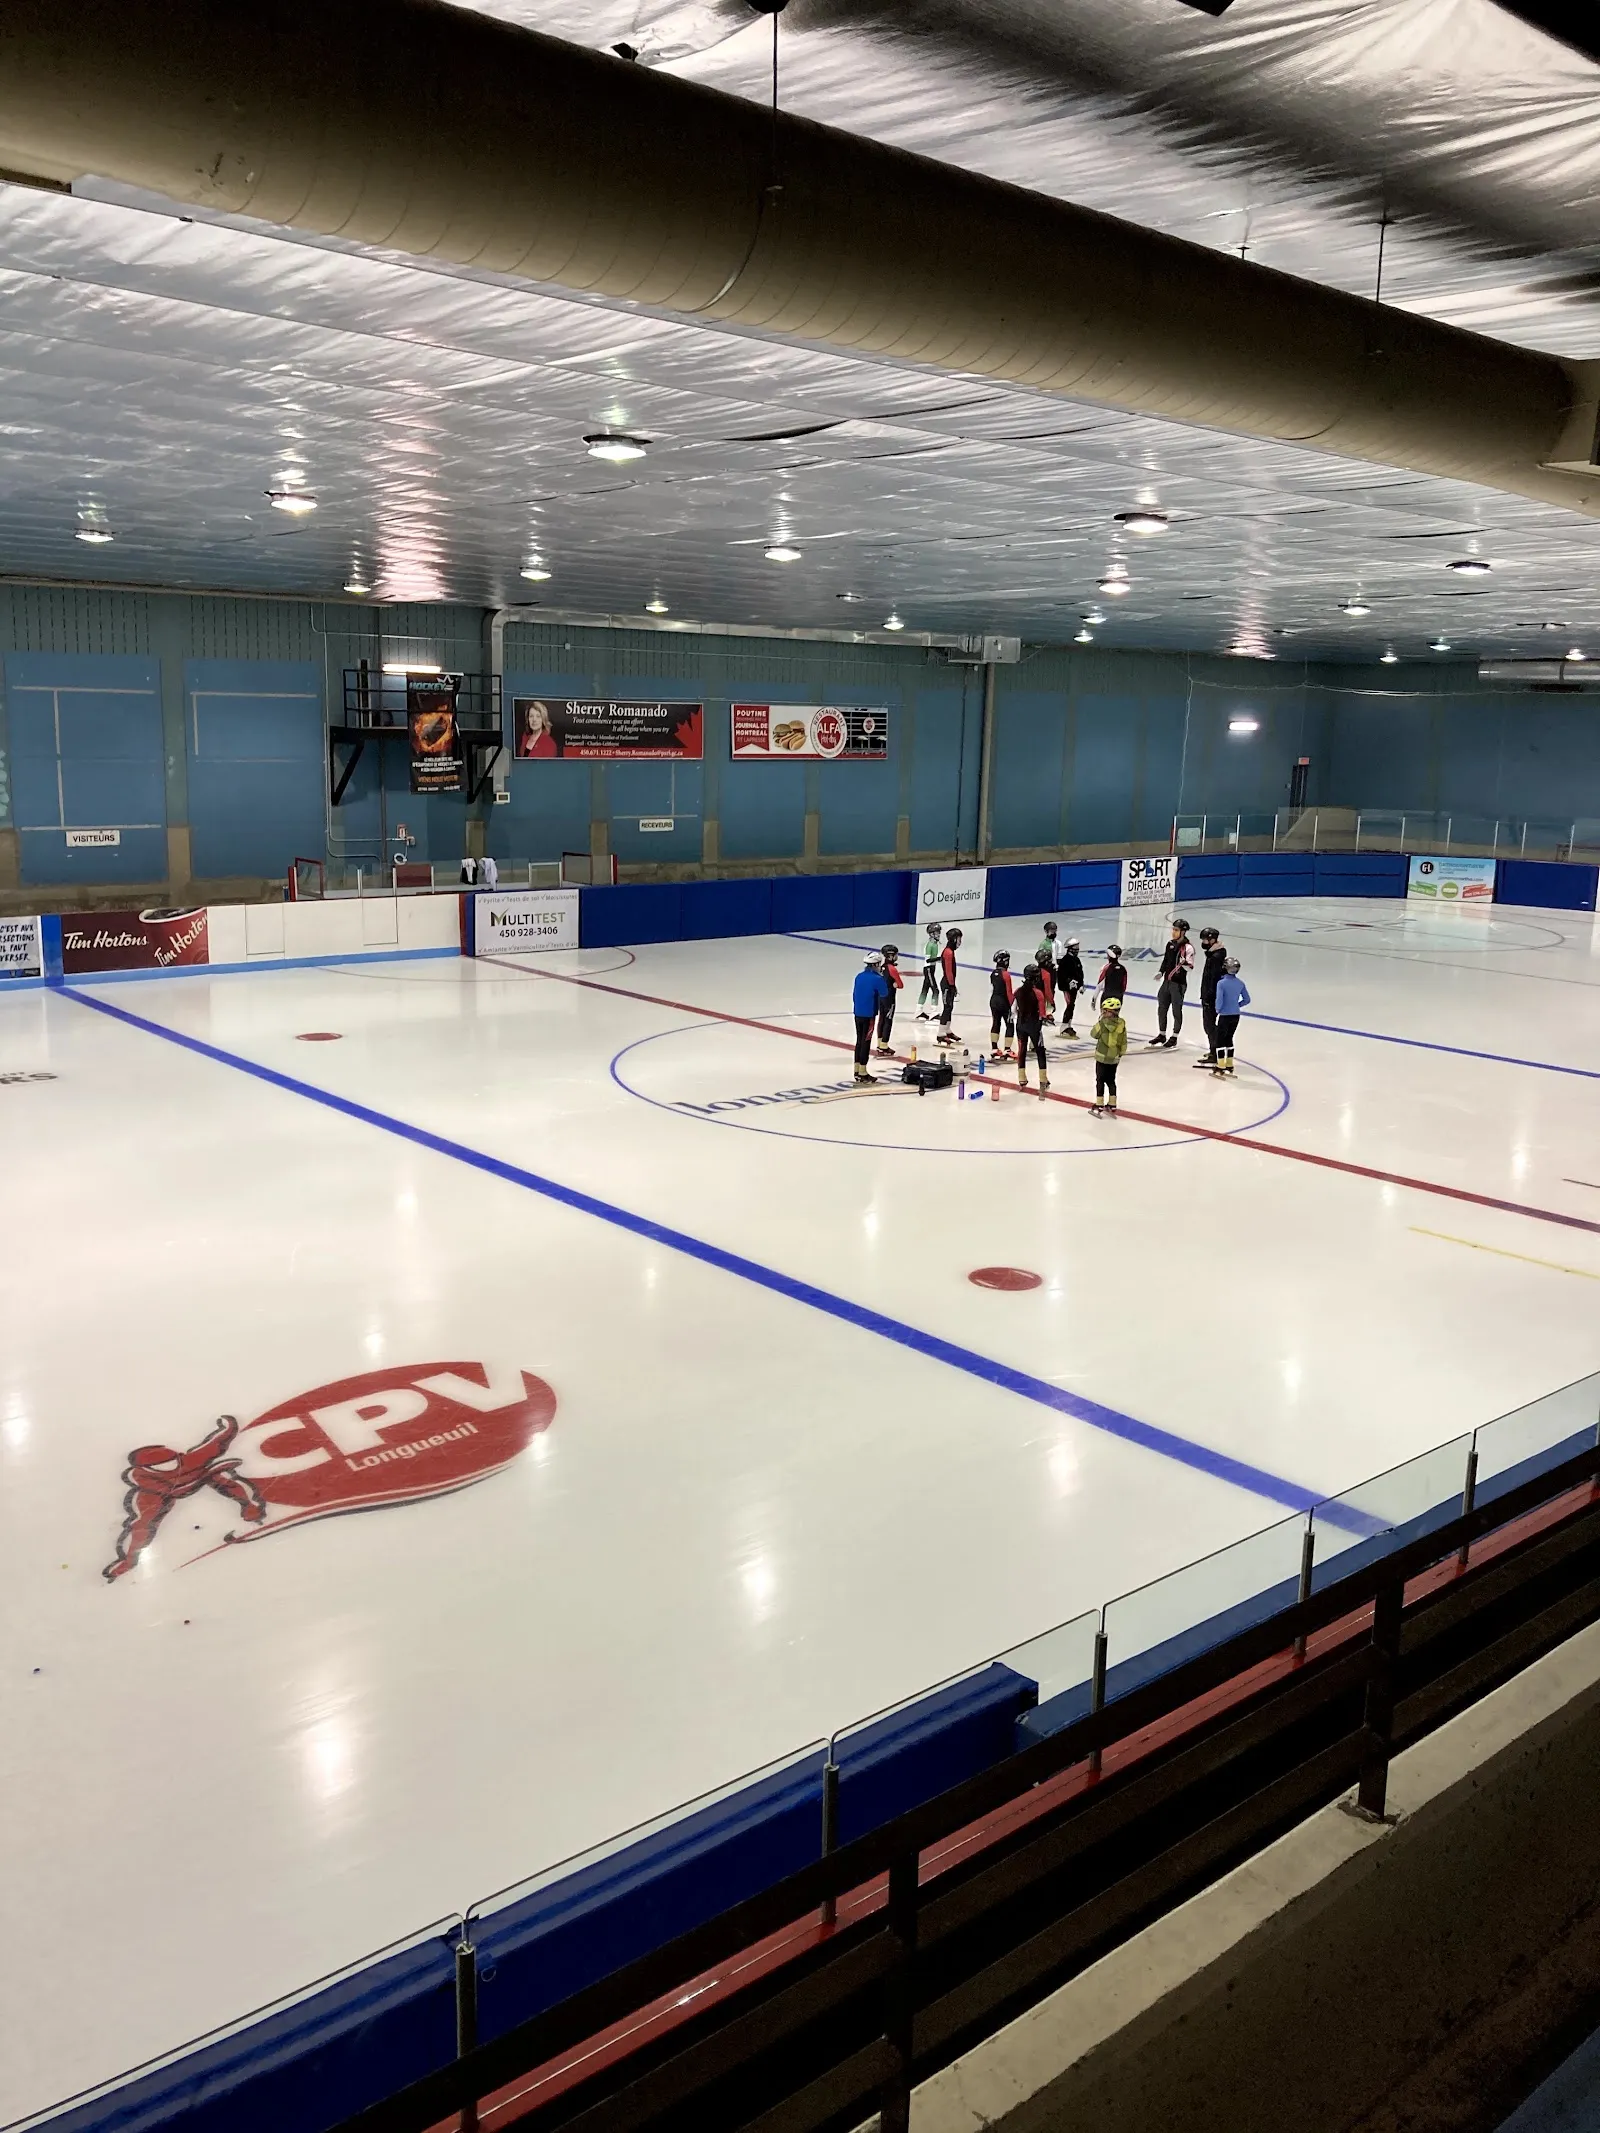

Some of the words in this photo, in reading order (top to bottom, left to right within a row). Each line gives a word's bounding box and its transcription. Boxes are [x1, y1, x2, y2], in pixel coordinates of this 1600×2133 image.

[565, 701, 605, 719] Sherry
[608, 703, 668, 717] Romanado
[813, 708, 846, 728] RESTAURANT
[817, 722, 841, 734] ALFA
[72, 833, 115, 843] VISITEURS
[1128, 878, 1170, 891] DIRECT.CA
[937, 888, 981, 904] Desjardins
[490, 907, 566, 927] MULTITEST
[20, 924, 34, 932] AUX
[499, 929, 516, 938] 450
[517, 926, 558, 937] 928-3406
[0, 933, 35, 943] SECTIONS
[63, 931, 92, 950] Tim
[93, 930, 148, 949] Hortons
[10, 943, 28, 952] FAUT
[154, 946, 177, 967] Tim
[229, 1362, 529, 1480] CPV
[344, 1420, 479, 1473] Longueuil
